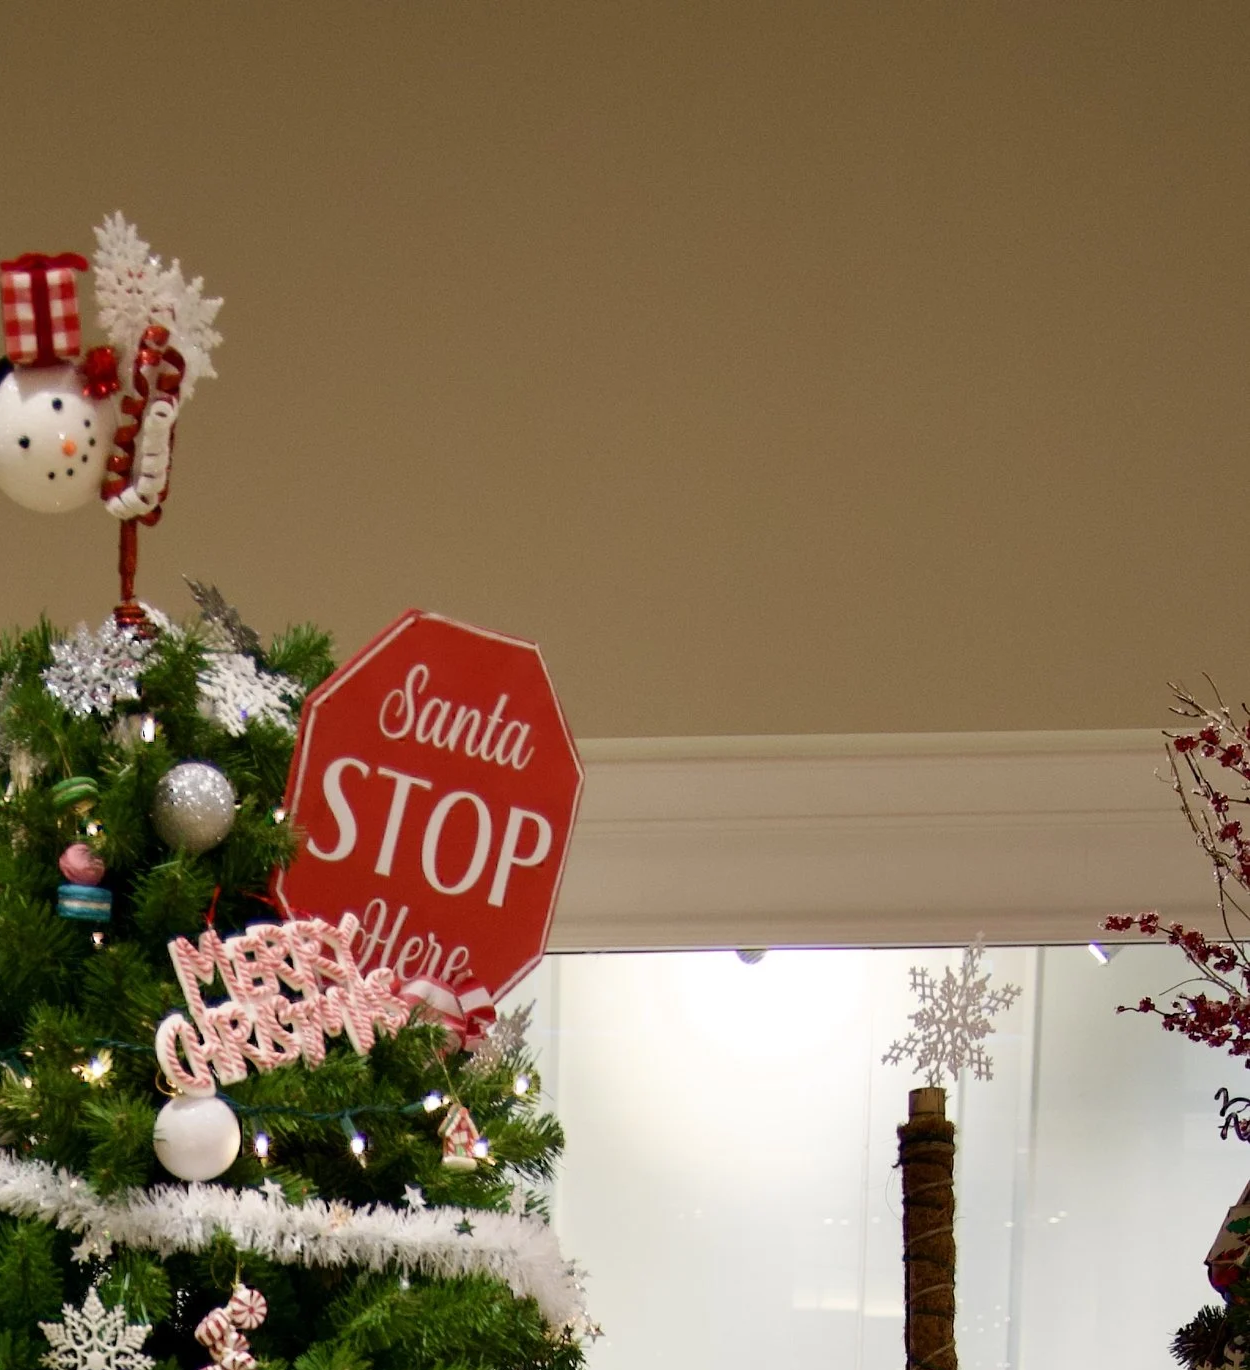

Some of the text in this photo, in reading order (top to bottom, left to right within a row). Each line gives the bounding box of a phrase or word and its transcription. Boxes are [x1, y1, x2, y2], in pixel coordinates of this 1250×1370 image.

[378, 663, 536, 770] Santa
[306, 757, 552, 908] STOP
[167, 911, 363, 1020] MERRY
[355, 898, 472, 981] Here
[155, 967, 411, 1098] CHRISTMAS
